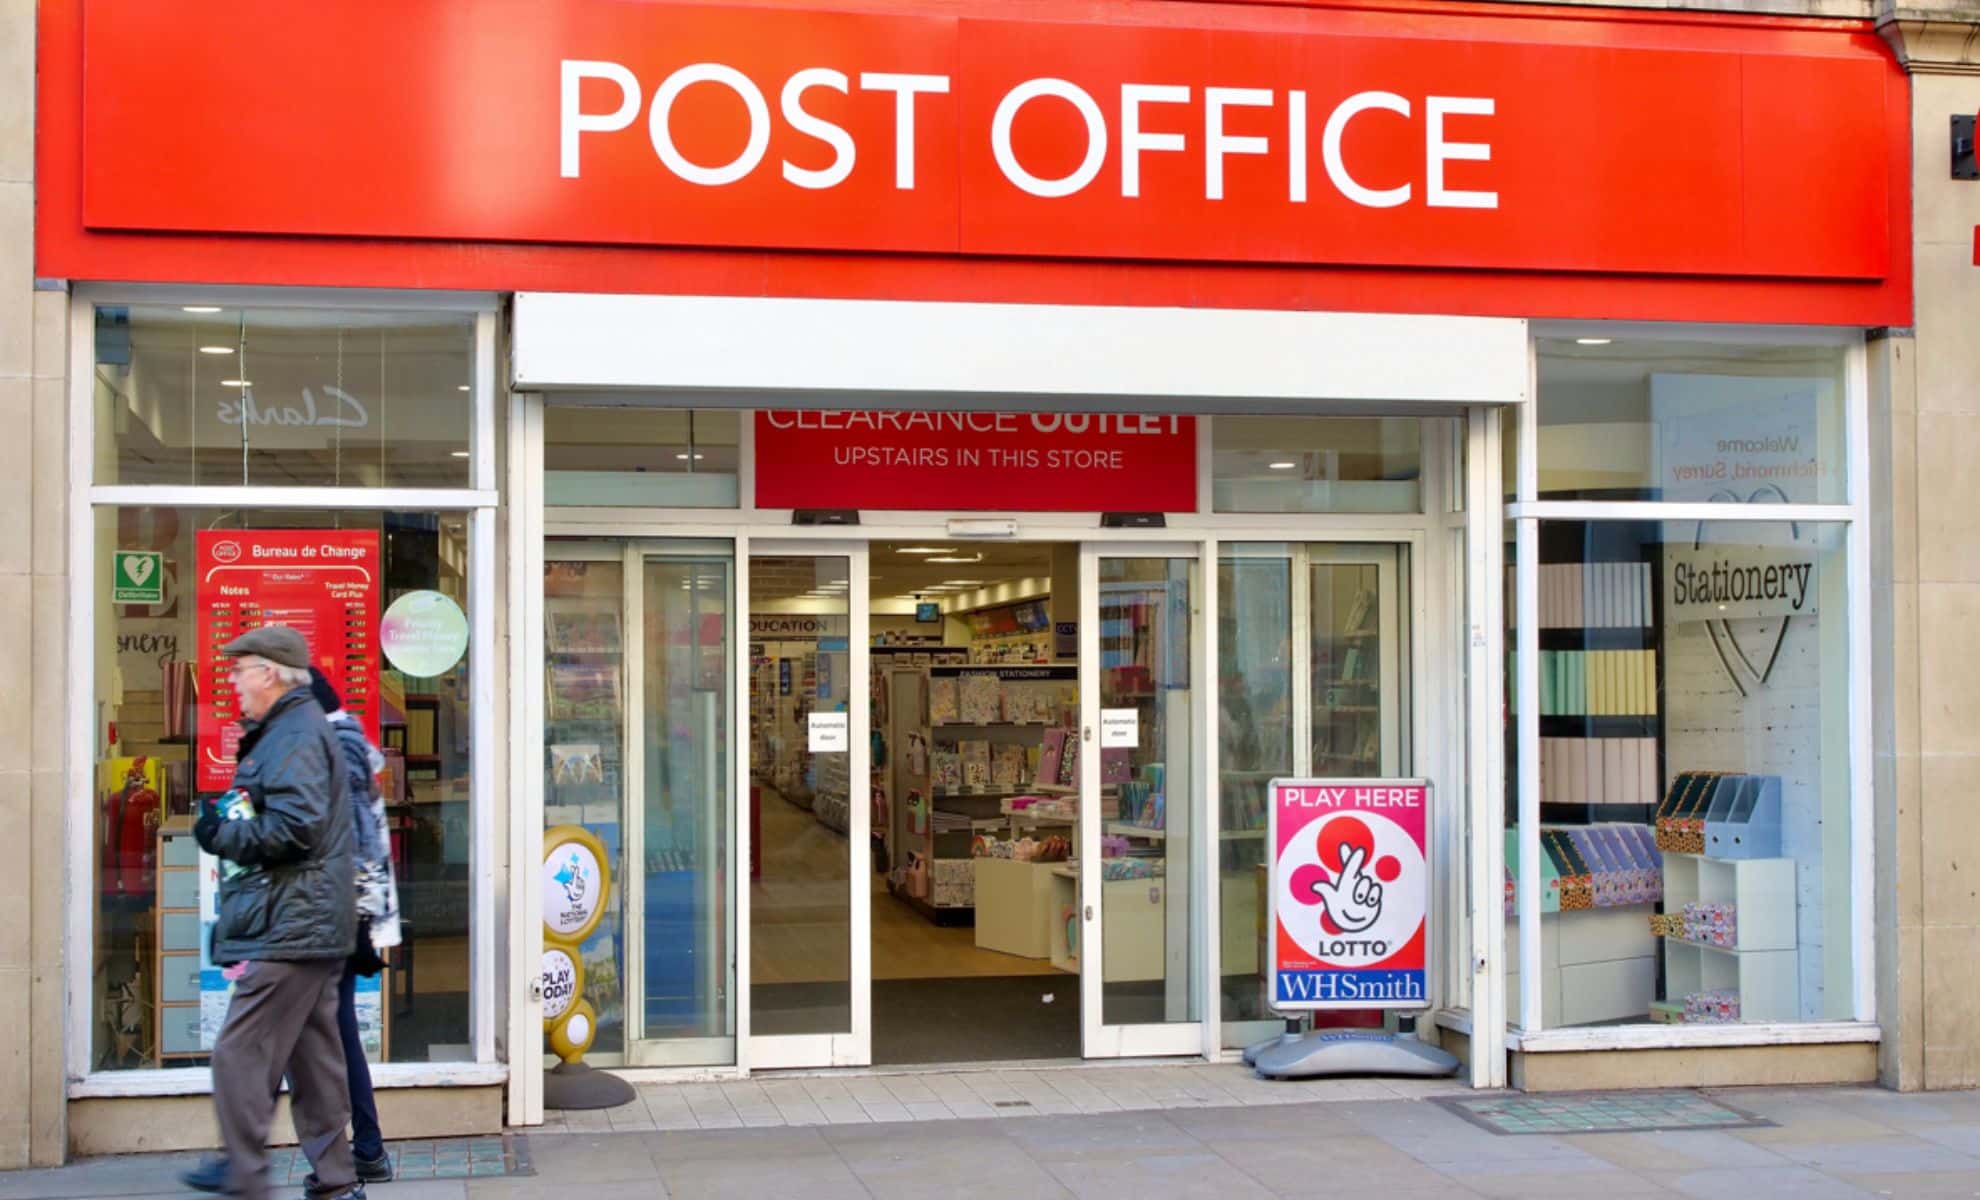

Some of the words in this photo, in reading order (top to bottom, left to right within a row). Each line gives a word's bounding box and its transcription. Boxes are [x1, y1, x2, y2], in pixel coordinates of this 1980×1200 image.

[560, 59, 950, 190] POST
[991, 77, 1498, 208] OFFICE
[767, 409, 1018, 432] CLEARANCE
[834, 446, 949, 466] UPSTAIRS
[956, 448, 979, 466] IN
[987, 448, 1039, 468] THIS
[1047, 449, 1123, 469] STORE
[252, 545, 297, 557] Bureau
[301, 545, 317, 557] de
[320, 545, 366, 559] Change
[220, 585, 249, 595] Notes
[1673, 560, 1812, 609] Stationery
[1284, 788, 1346, 807] PLAY
[1355, 788, 1419, 807] HERE
[1319, 940, 1387, 957] LOTTO
[543, 969, 570, 985] PLAY
[1280, 973, 1421, 1000] WHSmith
